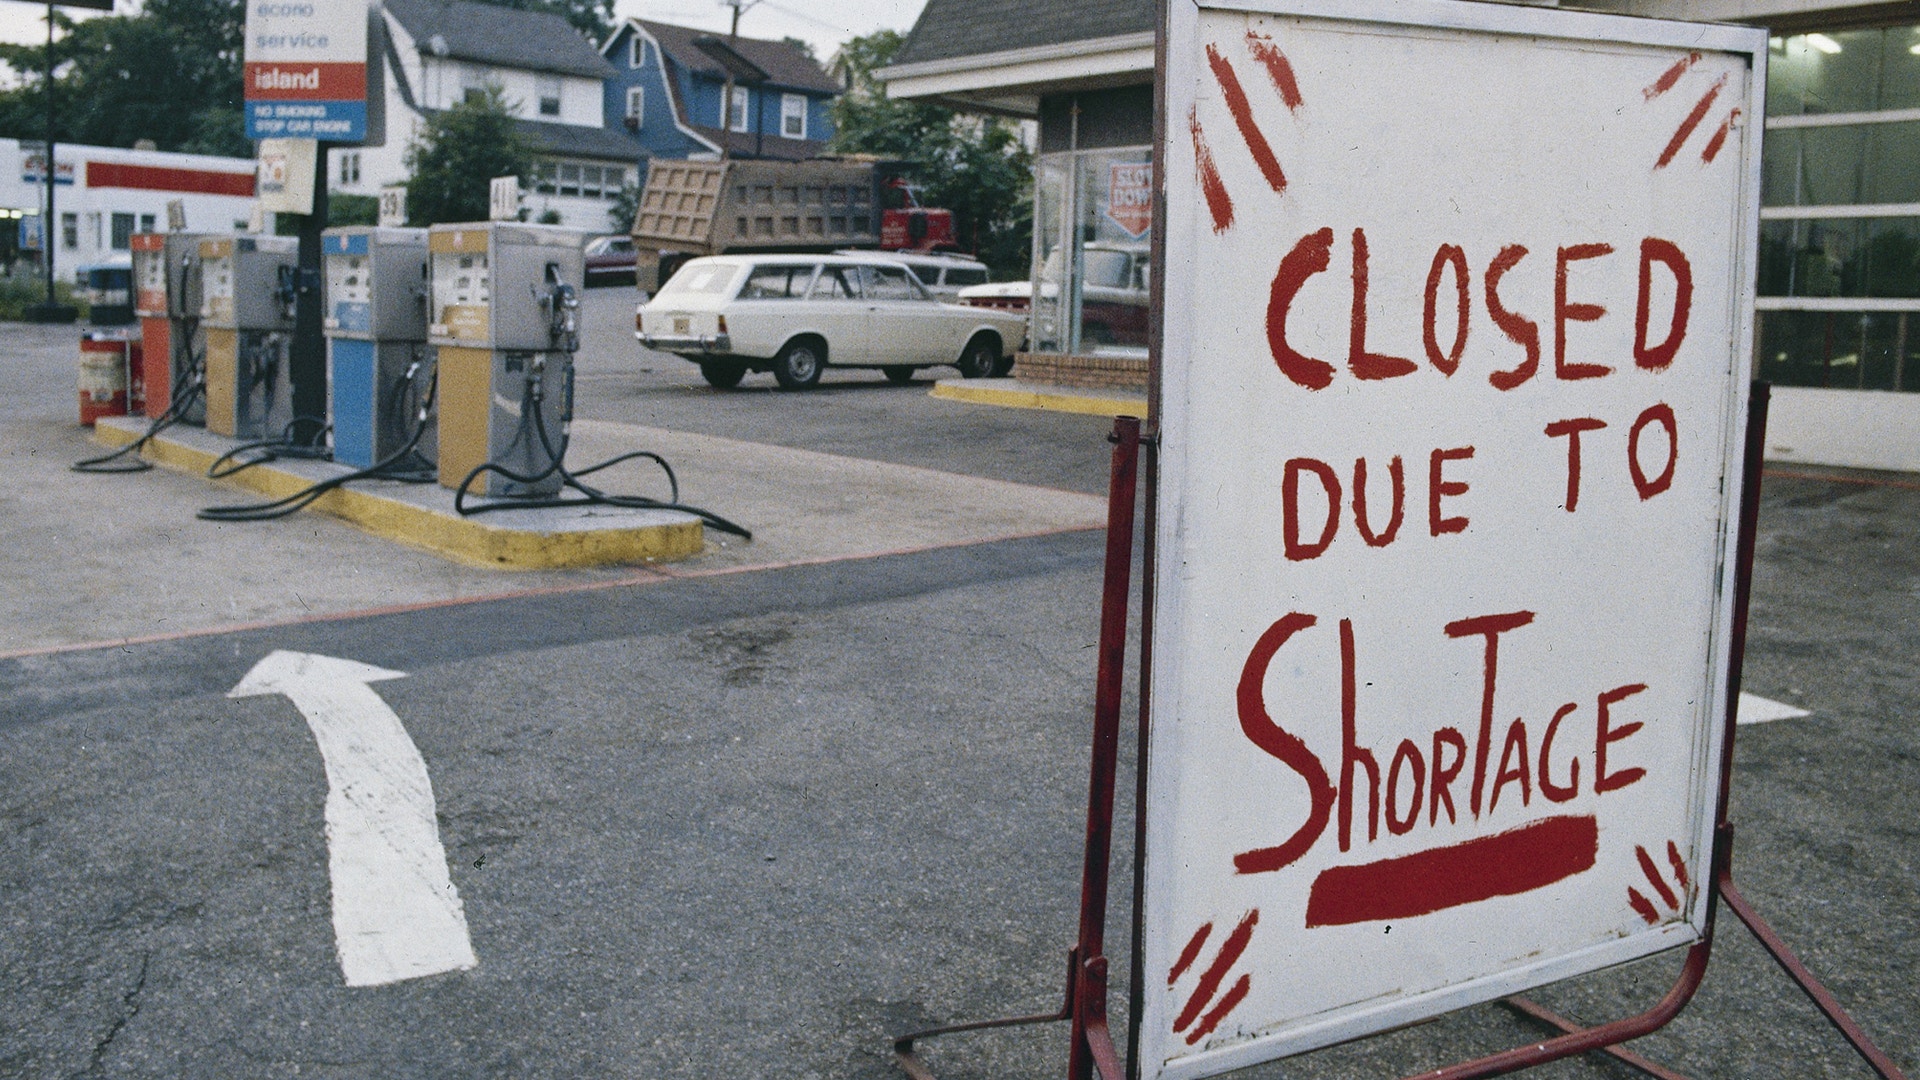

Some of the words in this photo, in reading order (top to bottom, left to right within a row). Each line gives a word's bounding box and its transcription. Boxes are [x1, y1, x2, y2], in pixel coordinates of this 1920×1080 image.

[257, 3, 313, 17] econo
[256, 35, 329, 48] service
[255, 67, 319, 89] island
[254, 105, 272, 117] NO
[275, 105, 326, 117] SMOKING
[255, 120, 285, 132] STOP
[287, 120, 311, 132] CAR
[313, 120, 351, 132] ENGINE
[1113, 188, 1152, 206] DOW
[1266, 227, 1693, 391] CLOSED
[1282, 447, 1475, 561] DUE
[1544, 403, 1677, 512] TO
